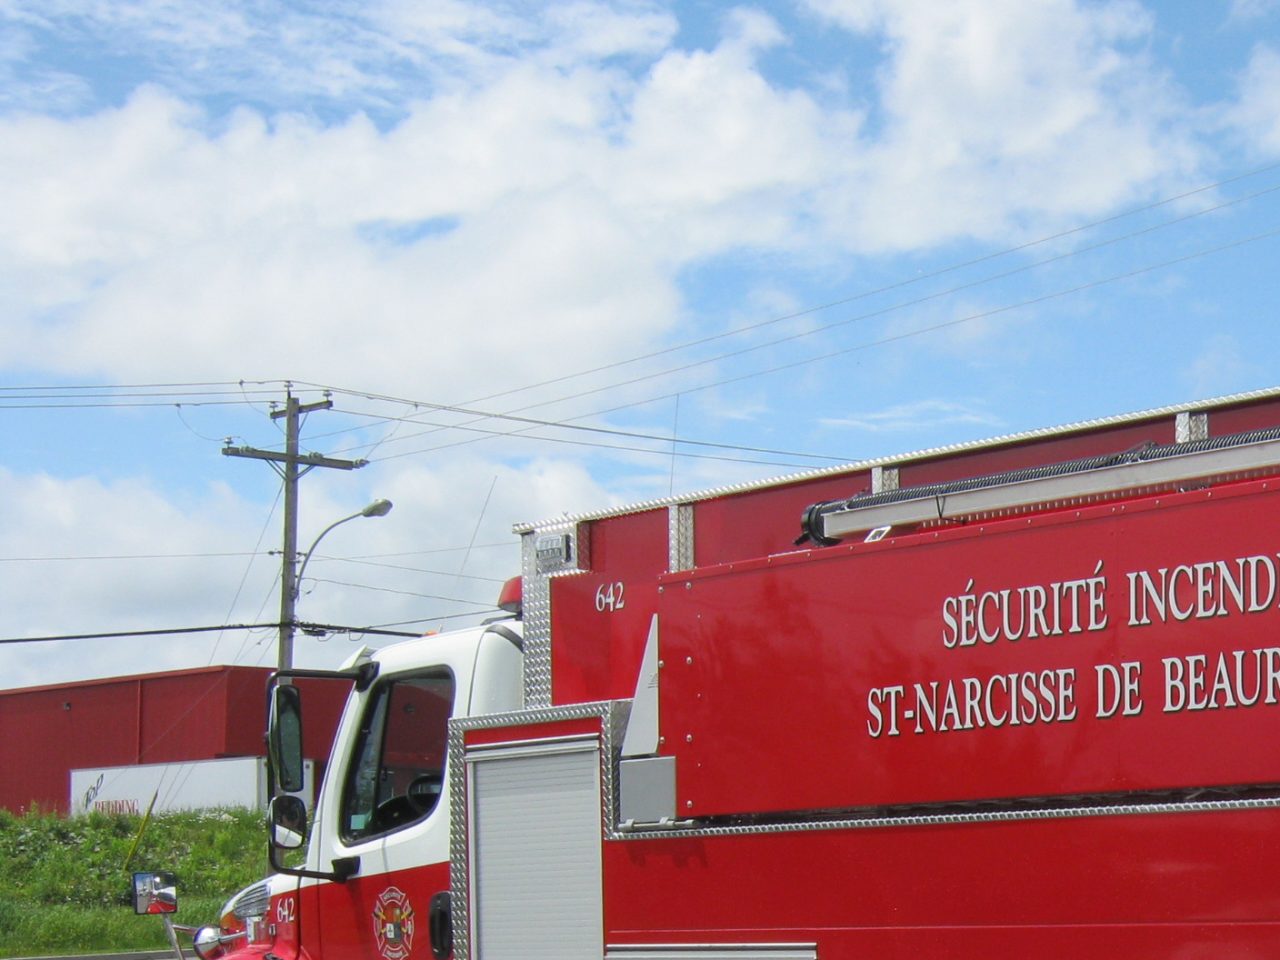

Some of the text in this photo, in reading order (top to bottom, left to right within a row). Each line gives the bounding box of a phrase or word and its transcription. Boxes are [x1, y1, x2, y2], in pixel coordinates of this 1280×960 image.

[595, 581, 625, 612] 642
[942, 560, 1108, 649] SÉCURITÉ
[867, 668, 1077, 738] ST-NARCISSE
[1095, 661, 1142, 718] DE
[276, 897, 295, 923] 642
